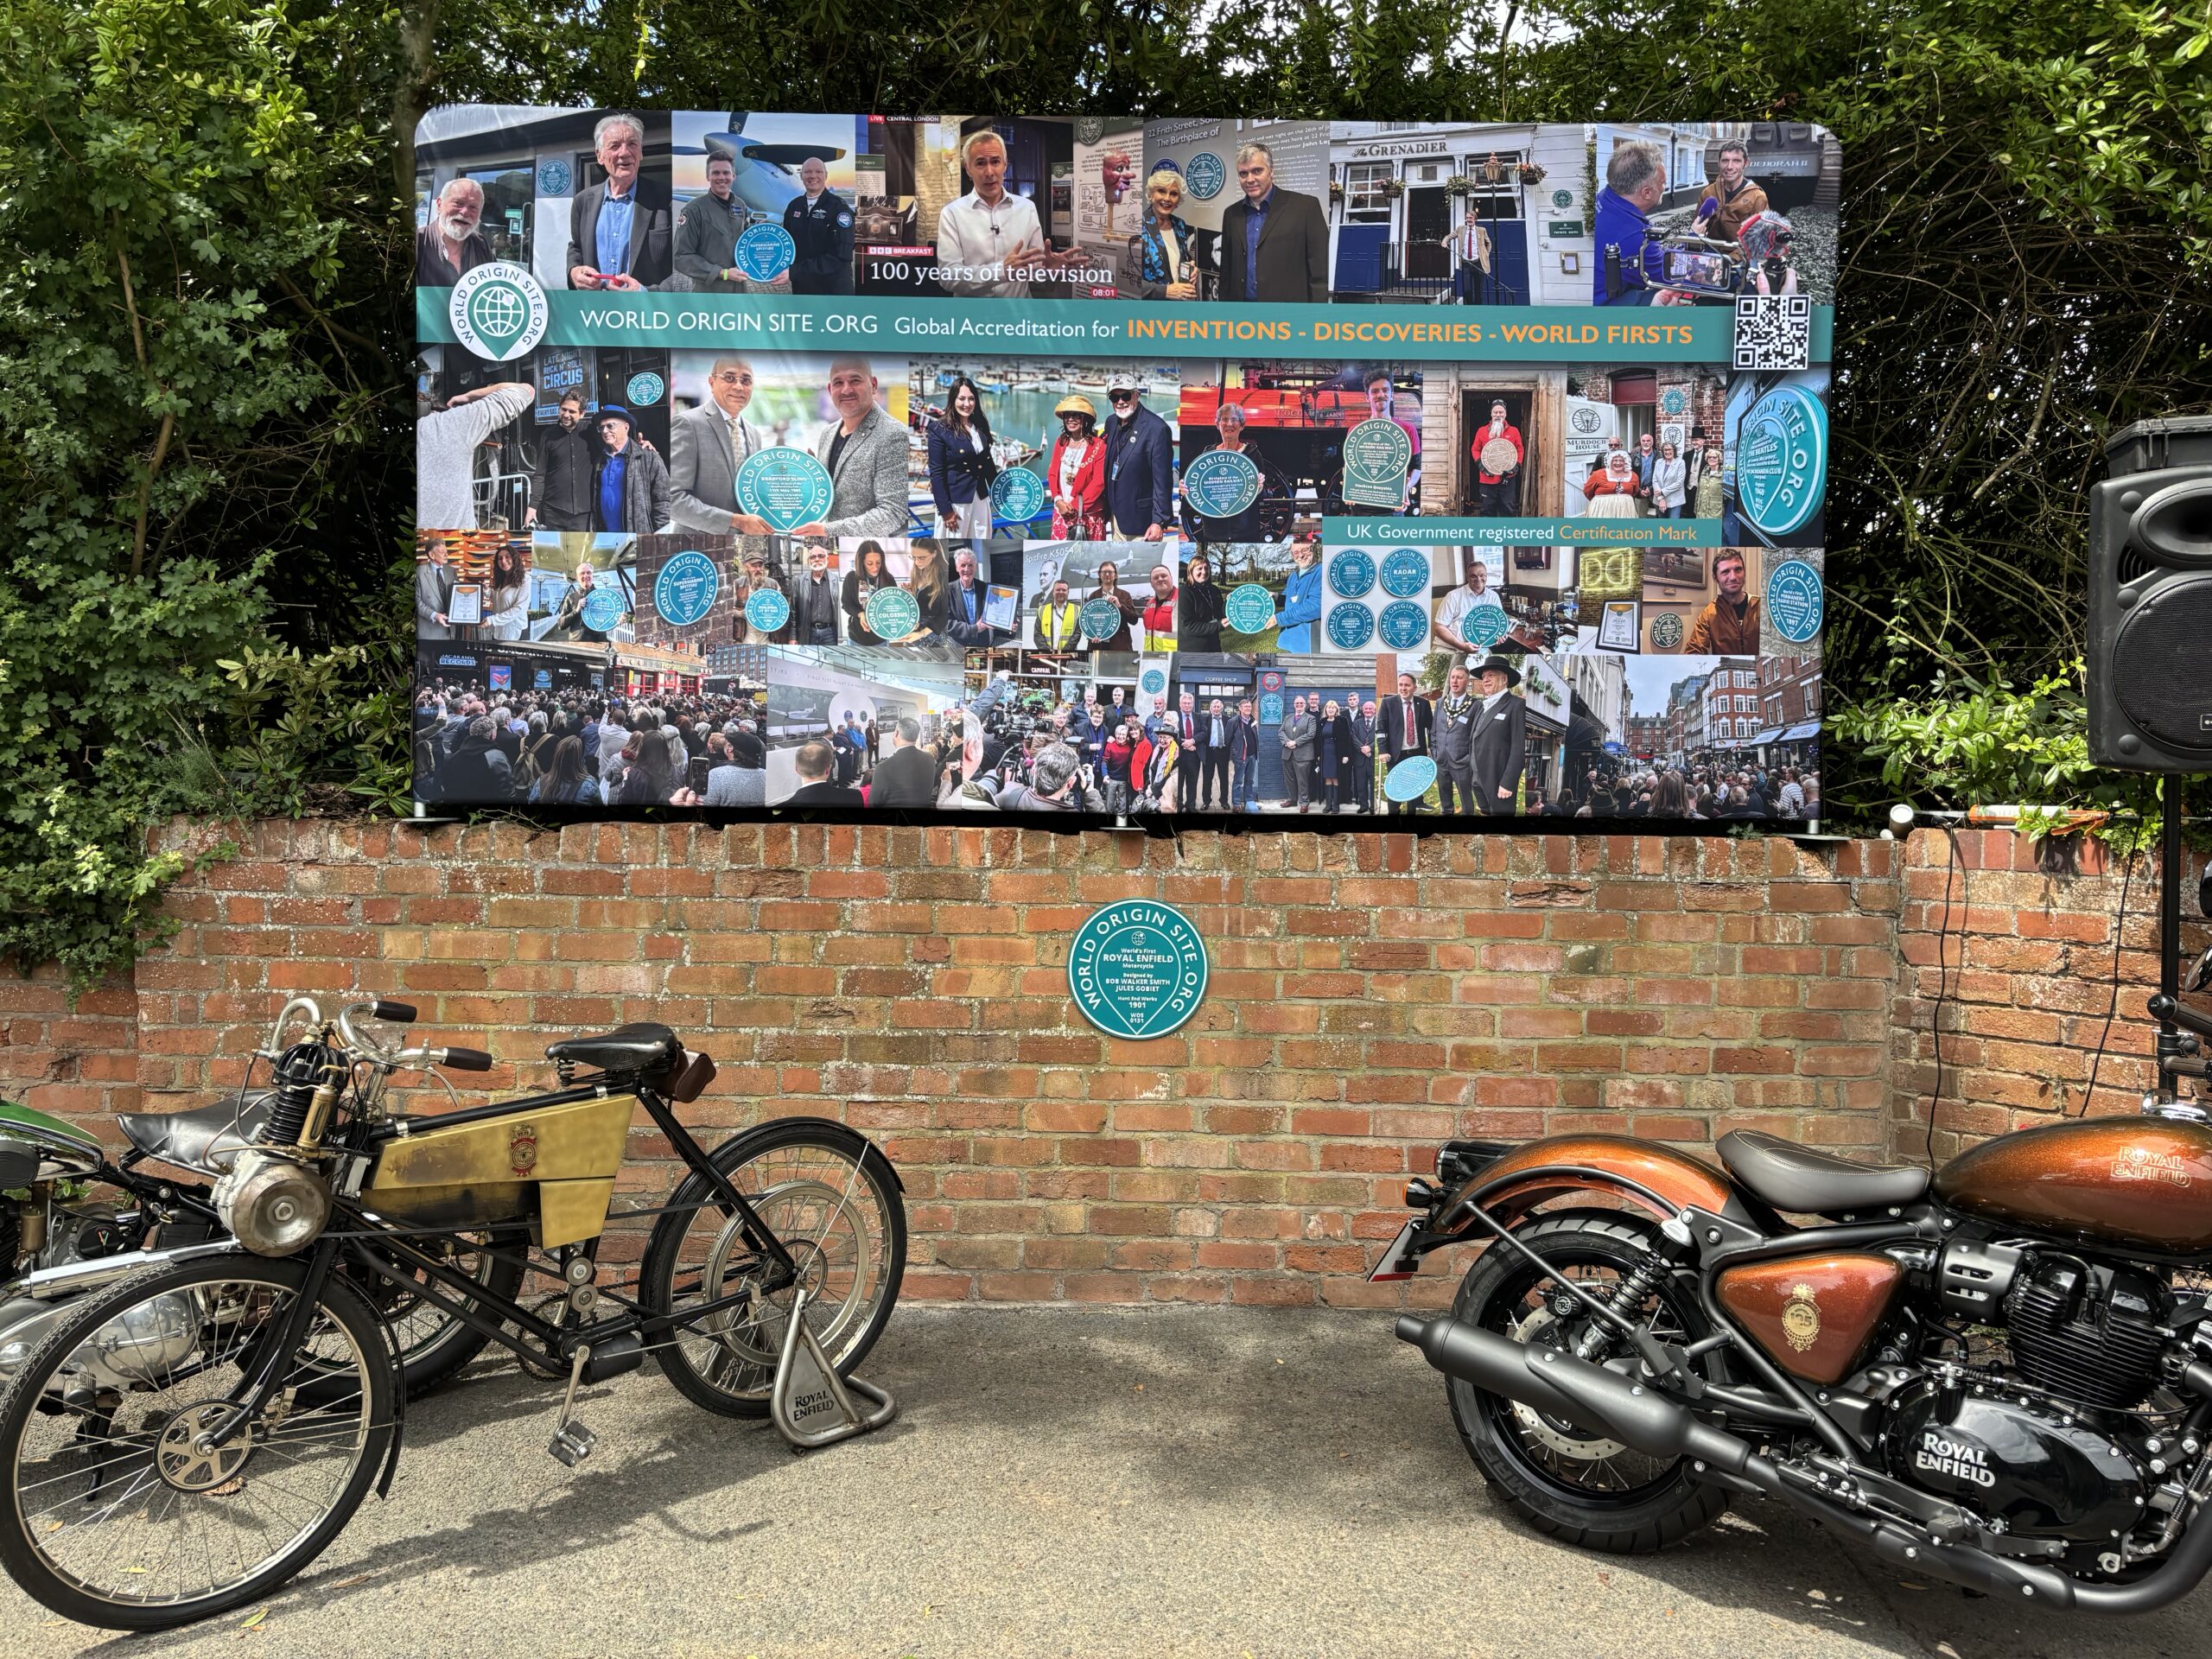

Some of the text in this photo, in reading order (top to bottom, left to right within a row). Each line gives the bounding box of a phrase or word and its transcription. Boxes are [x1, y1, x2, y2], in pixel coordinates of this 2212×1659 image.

[1157, 125, 1173, 136] Frith
[1173, 120, 1198, 131] Street,
[1157, 126, 1220, 148] The Birthplace of
[1302, 140, 1318, 149] John
[1369, 142, 1447, 156] GRENADIER
[1192, 155, 1211, 166] ORIGIN
[739, 238, 749, 269] WORLD
[747, 226, 777, 238] ORIGIN
[870, 262, 1113, 285] 100 years of television
[455, 289, 474, 344] WORLD
[468, 267, 520, 286] ORIGIN
[581, 309, 670, 330] WORLD
[677, 313, 761, 331] ORIGIN
[768, 313, 813, 332] SITE
[821, 315, 878, 334] .ORG
[894, 317, 955, 335] Global
[959, 318, 1085, 338] Accreditation
[1092, 321, 1119, 338] for
[1128, 320, 1291, 340] INVENTIONS
[1314, 322, 1481, 343] DISCOVERIES
[1501, 325, 1599, 343] WORLD
[1607, 325, 1694, 344] FIRSTS
[543, 348, 582, 366] LATE NIGHT
[543, 365, 558, 373] ROCK
[567, 359, 583, 370] ROLL
[543, 368, 583, 389] CIRCUS
[1744, 398, 1776, 435] ORIGIN
[1348, 436, 1357, 468] WORLD
[1357, 423, 1391, 435] ORIGIN
[742, 469, 760, 513] WORLD
[754, 451, 801, 467] ORIGIN
[1001, 471, 1027, 482] ORIGIN
[1190, 472, 1205, 507] WORLD
[1198, 454, 1238, 470] ORIGIN
[1347, 524, 1697, 543] UK Government registered Certification Mark
[1025, 553, 1047, 563] Spitfire
[1331, 563, 1340, 588] WORLD
[1338, 551, 1363, 562] ORIGIN
[1383, 563, 1392, 588] WORLD
[1389, 550, 1415, 562] ORIGIN
[660, 577, 672, 615] WORLD
[669, 556, 701, 574] ORIGIN
[1236, 587, 1260, 596] ORIGIN
[1770, 584, 1780, 623] WORLD
[1777, 567, 1805, 582] ORIGIN
[868, 602, 880, 630] WORLD
[875, 589, 902, 601] ORIGIN
[1790, 600, 1808, 608] STATION
[1329, 615, 1338, 639] WORLD
[1336, 603, 1361, 613] ORIGIN
[1382, 615, 1391, 640] WORLD
[1389, 603, 1414, 613] ORIGIN
[1078, 939, 1102, 1010] WORLD
[1096, 909, 1166, 934] ORIGIN
[1103, 954, 1173, 963] ROYAL ENFIELD
[2119, 1146, 2184, 1170] ROYAL
[2110, 1161, 2191, 1188] ENFIELD
[793, 1400, 835, 1421] ENFIELD
[795, 1390, 829, 1408] ROYAL
[1923, 1433, 1987, 1467] ROYAL
[1916, 1450, 1996, 1487] ENFIELD
